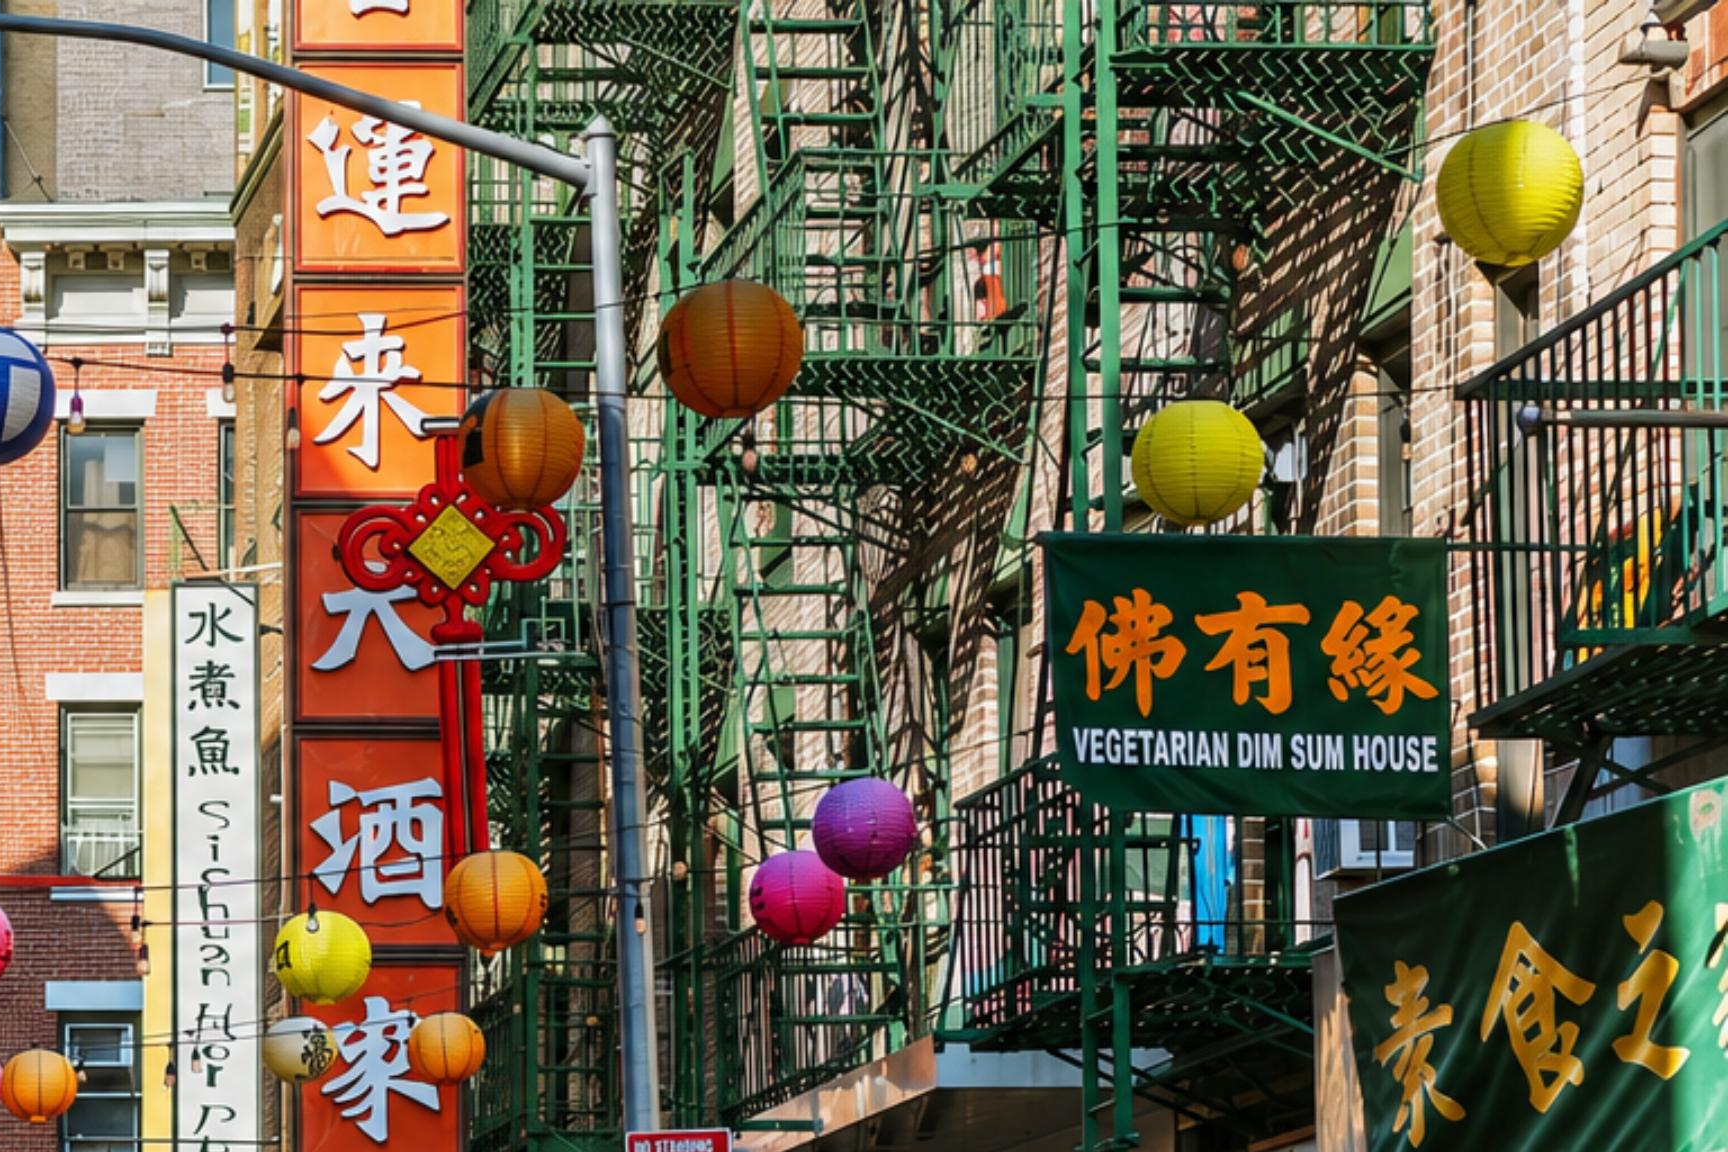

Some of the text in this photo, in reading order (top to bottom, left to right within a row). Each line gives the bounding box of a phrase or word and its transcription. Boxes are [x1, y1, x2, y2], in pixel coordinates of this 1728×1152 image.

[307, 0, 451, 1143] 運来大酒家
[1065, 587, 1440, 718] 佛有緣
[185, 602, 244, 777] 水煮魚
[1072, 727, 1439, 773] VEGETARIAN DIM SUM HOUSE
[1374, 900, 1728, 1149] 素食之
